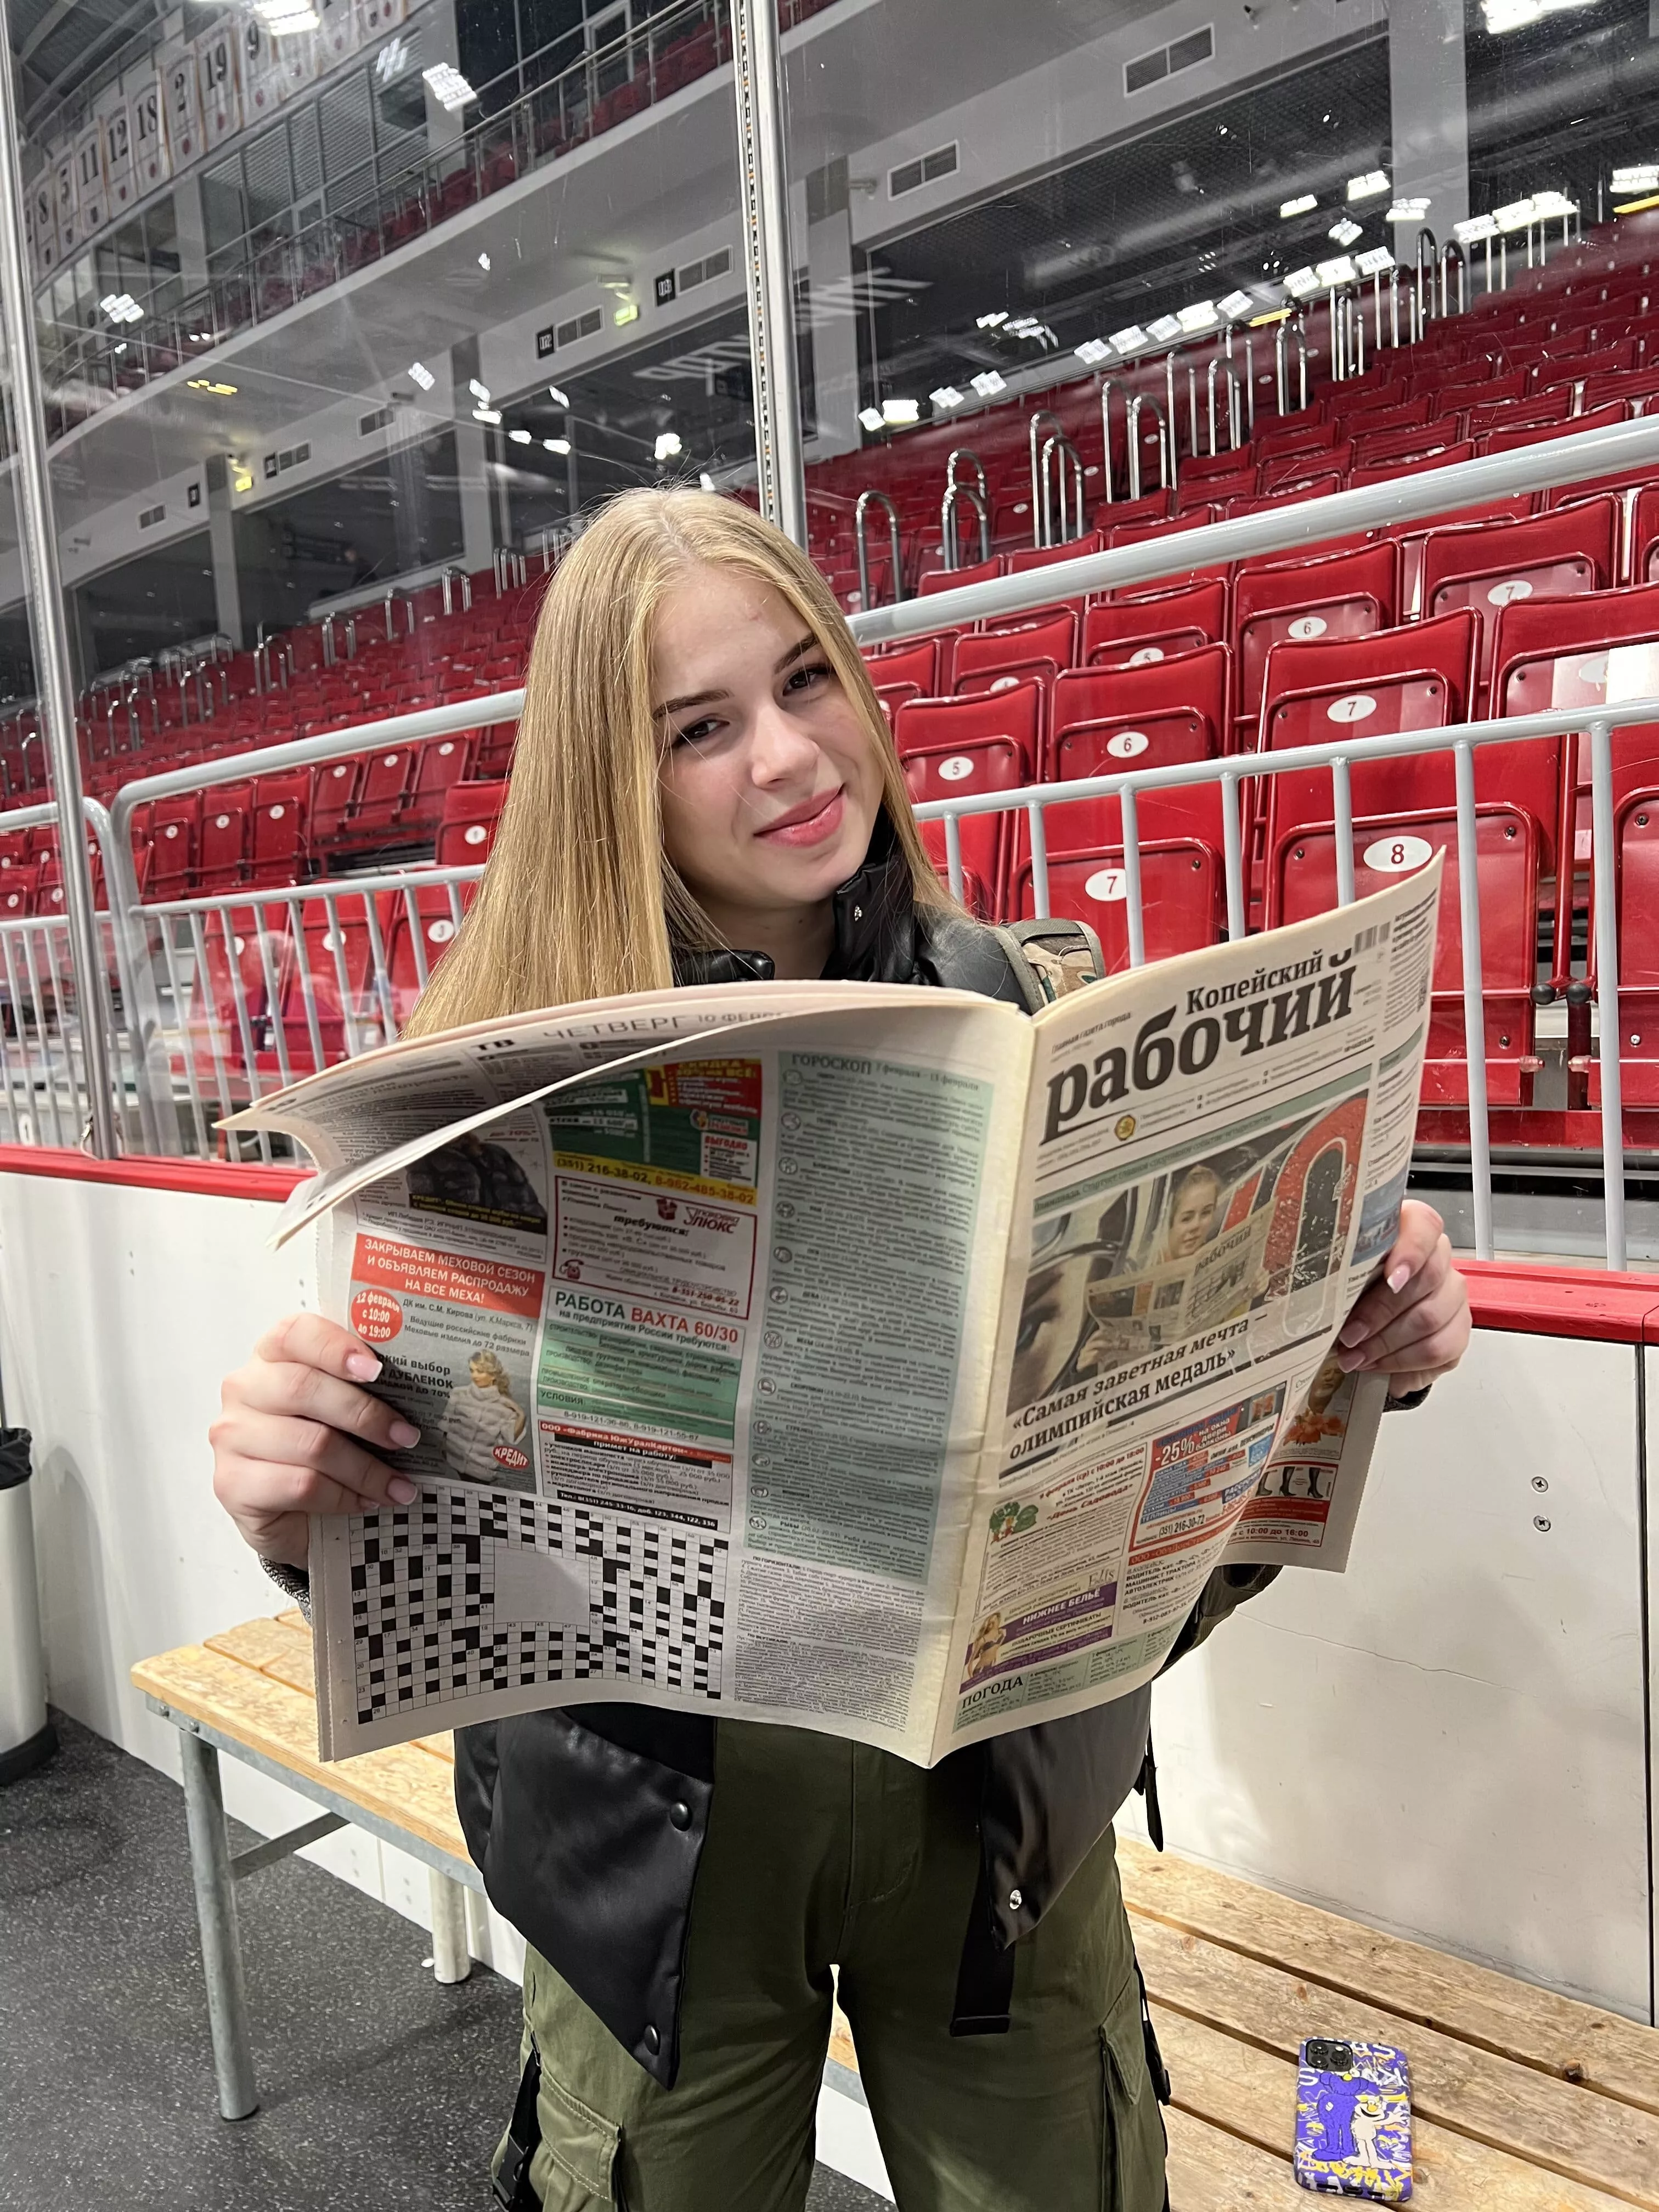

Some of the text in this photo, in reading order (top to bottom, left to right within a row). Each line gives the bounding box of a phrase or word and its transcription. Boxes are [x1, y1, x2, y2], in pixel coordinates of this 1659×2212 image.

[205, 42, 227, 92] 19
[137, 95, 157, 141] 18
[109, 119, 128, 163] 12
[81, 143, 99, 186] 11
[1302, 621, 1312, 635] 6
[1347, 702, 1358, 716] 7
[1122, 737, 1132, 752] 6
[952, 761, 962, 775] 5
[1390, 844, 1405, 865] 8
[1106, 876, 1119, 895] 7
[1186, 948, 1323, 1015] Копейский
[543, 1015, 687, 1039] ЧЕТВЕРГ
[477, 1039, 516, 1051] ТВ
[1039, 947, 1356, 1147] рабочий
[792, 1053, 871, 1075] ГОРОСКОП
[364, 1238, 535, 1284] ЗАКРЫВАЕМ МЕХОВОЙ СЕЗОН
[367, 1256, 529, 1297] И ОБЪЯВЛЯЕМ РАСПРОДАЖУ
[356, 1290, 400, 1313] 12 февраля
[405, 1279, 485, 1304] НА ВСЕ МЕХА!
[368, 1307, 391, 1323] 10:00
[403, 1298, 414, 1308] ДК
[445, 1308, 474, 1319] Кирова
[555, 1290, 739, 1344] РАБОТА ВАХТА 60/30
[358, 1324, 392, 1339] до 19:00
[409, 1316, 527, 1346] Ведущие российские фабрики
[558, 1309, 571, 1318] на
[572, 1311, 637, 1332] предприятия
[638, 1324, 673, 1340] России
[404, 1324, 439, 1338] Меховые
[440, 1331, 471, 1345] изделия
[484, 1340, 495, 1350] 72
[495, 1344, 530, 1358] размера
[410, 1361, 451, 1376] выбор
[1012, 1322, 1249, 1431] «Самая заветная мечта
[388, 1370, 454, 1389] ДУБЛЕНОК
[1009, 1383, 1150, 1460] олимпийская
[1154, 1348, 1235, 1395] медаль»
[541, 1423, 561, 1432] ООО
[1210, 1418, 1230, 1430] окна
[494, 1447, 529, 1467] КРЕДИТ
[594, 1441, 627, 1452] примет
[642, 1448, 676, 1461] работу:
[1155, 1435, 1195, 1466] -25%
[1246, 1527, 1269, 1535] 10:00
[1125, 1572, 1164, 1588] МАШИНИСТ
[1126, 1567, 1161, 1581] ВОДИТЕЛЬ
[1124, 1576, 1175, 1595] АВТОЭЛЕКТРИК
[1023, 1603, 1066, 1625] НИЖНЕЕ
[1068, 1589, 1101, 1607] БЕЛЬЕ
[1122, 1596, 1157, 1610] ВОДИТЕЛЬ
[961, 1676, 1024, 1709] ПОГОДА
